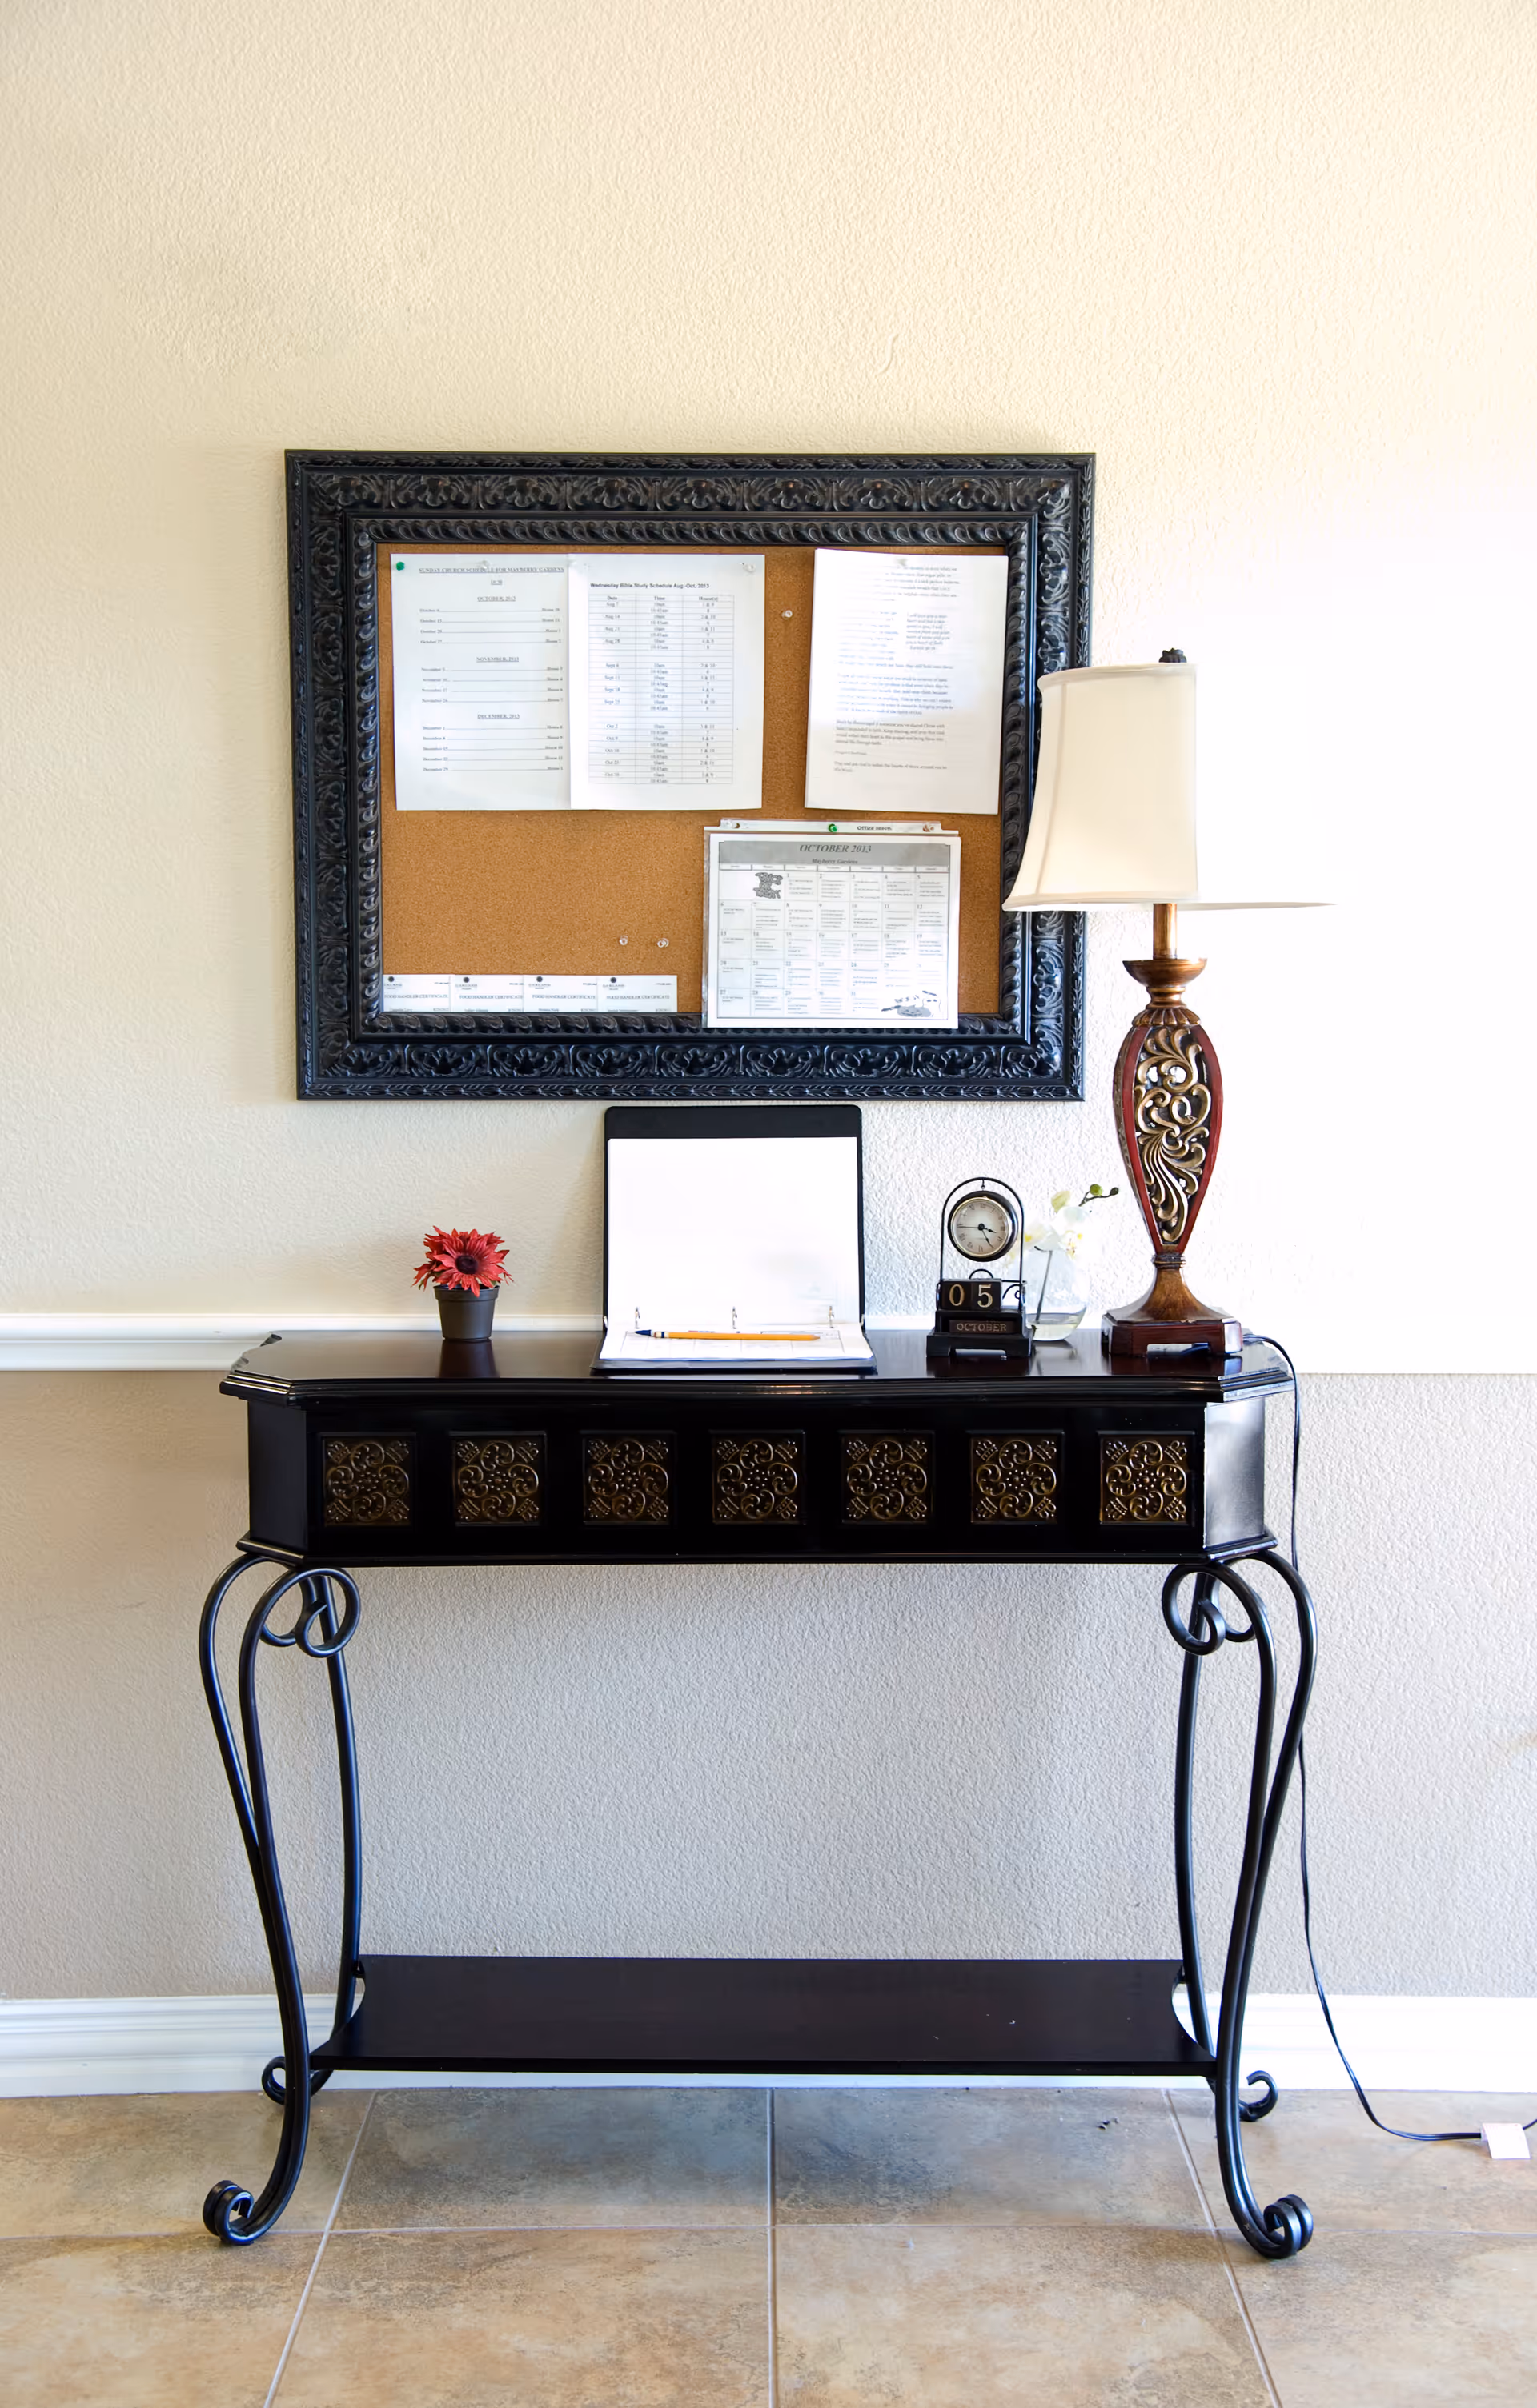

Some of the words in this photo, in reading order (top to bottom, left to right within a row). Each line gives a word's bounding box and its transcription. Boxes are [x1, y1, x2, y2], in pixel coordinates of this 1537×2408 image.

[800, 844, 849, 853] OCTOBER
[851, 845, 872, 853] 2013
[957, 1323, 1007, 1332] OCTOBER
